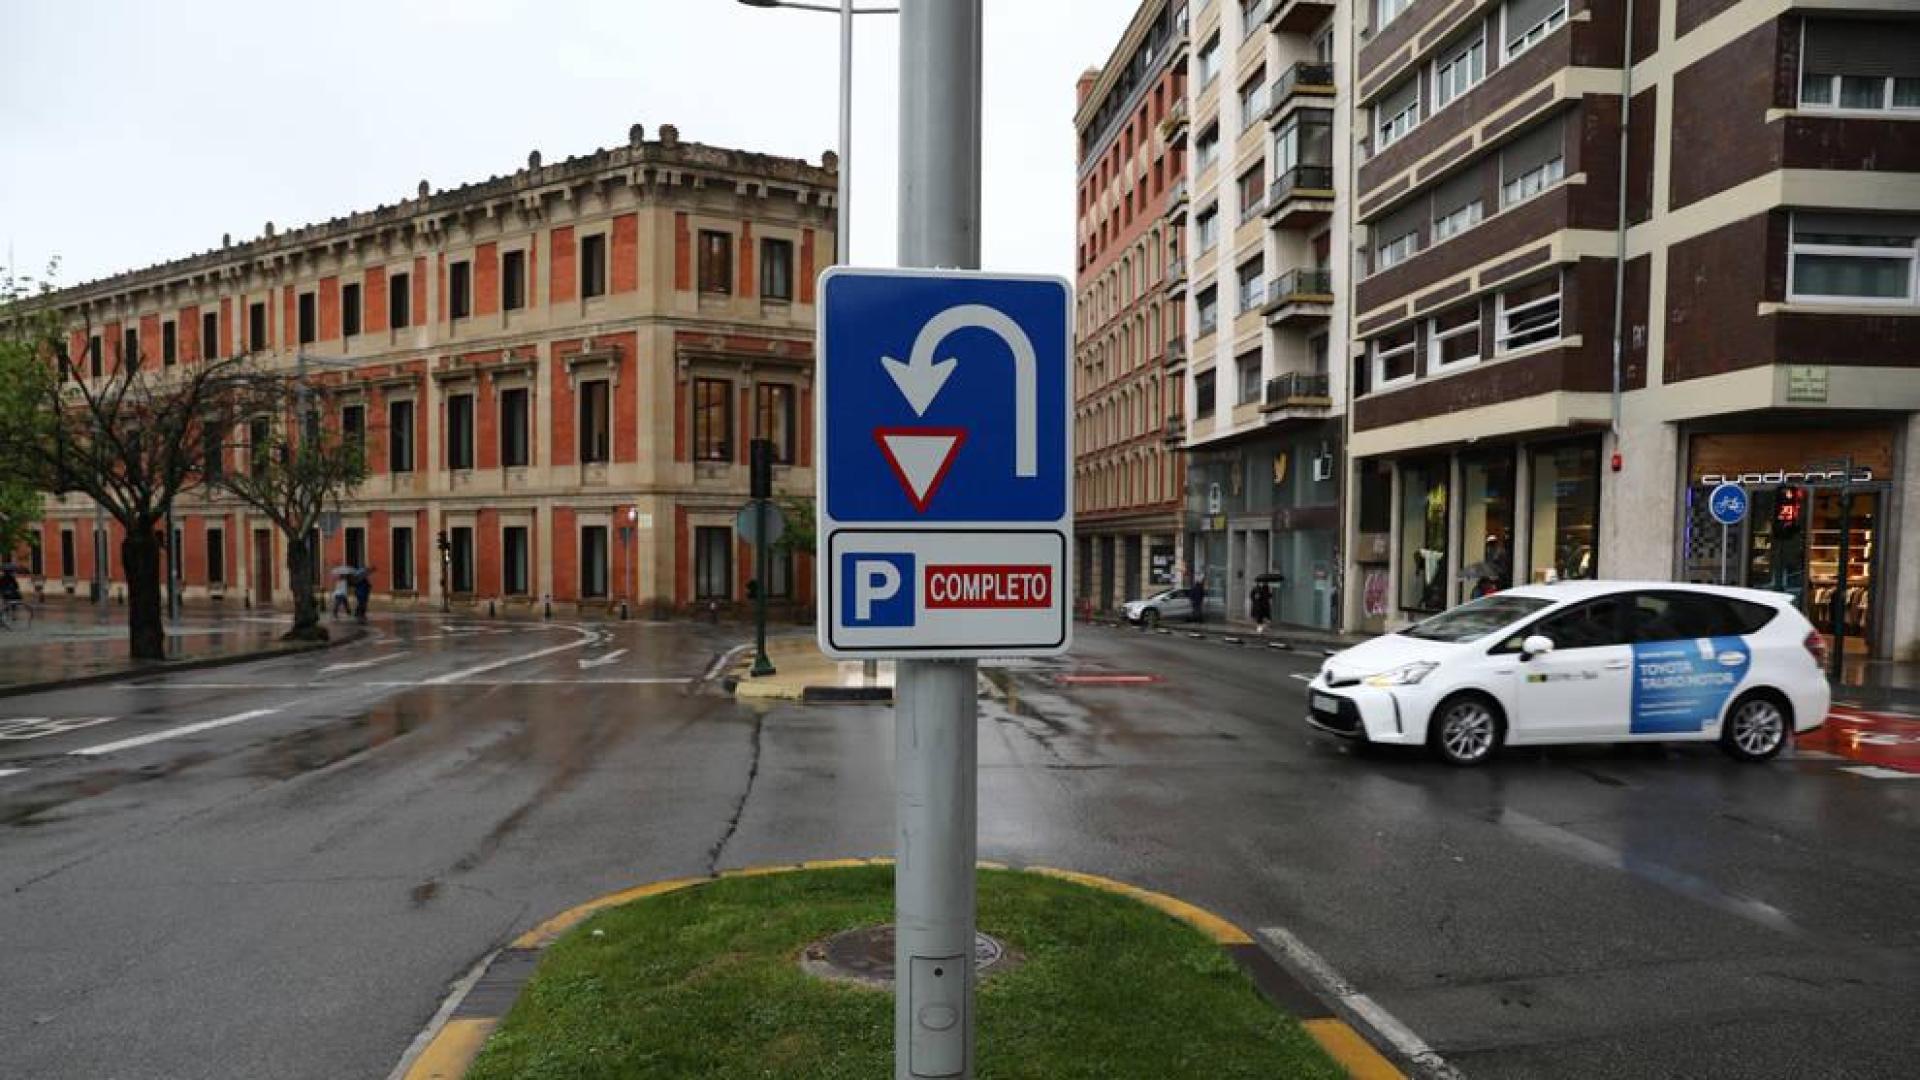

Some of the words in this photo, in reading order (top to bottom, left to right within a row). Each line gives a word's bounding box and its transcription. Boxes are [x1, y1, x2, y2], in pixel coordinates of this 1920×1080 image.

[855, 560, 901, 620] P
[930, 572, 1047, 601] COMPLETO
[1639, 661, 1692, 676] TOYOTA
